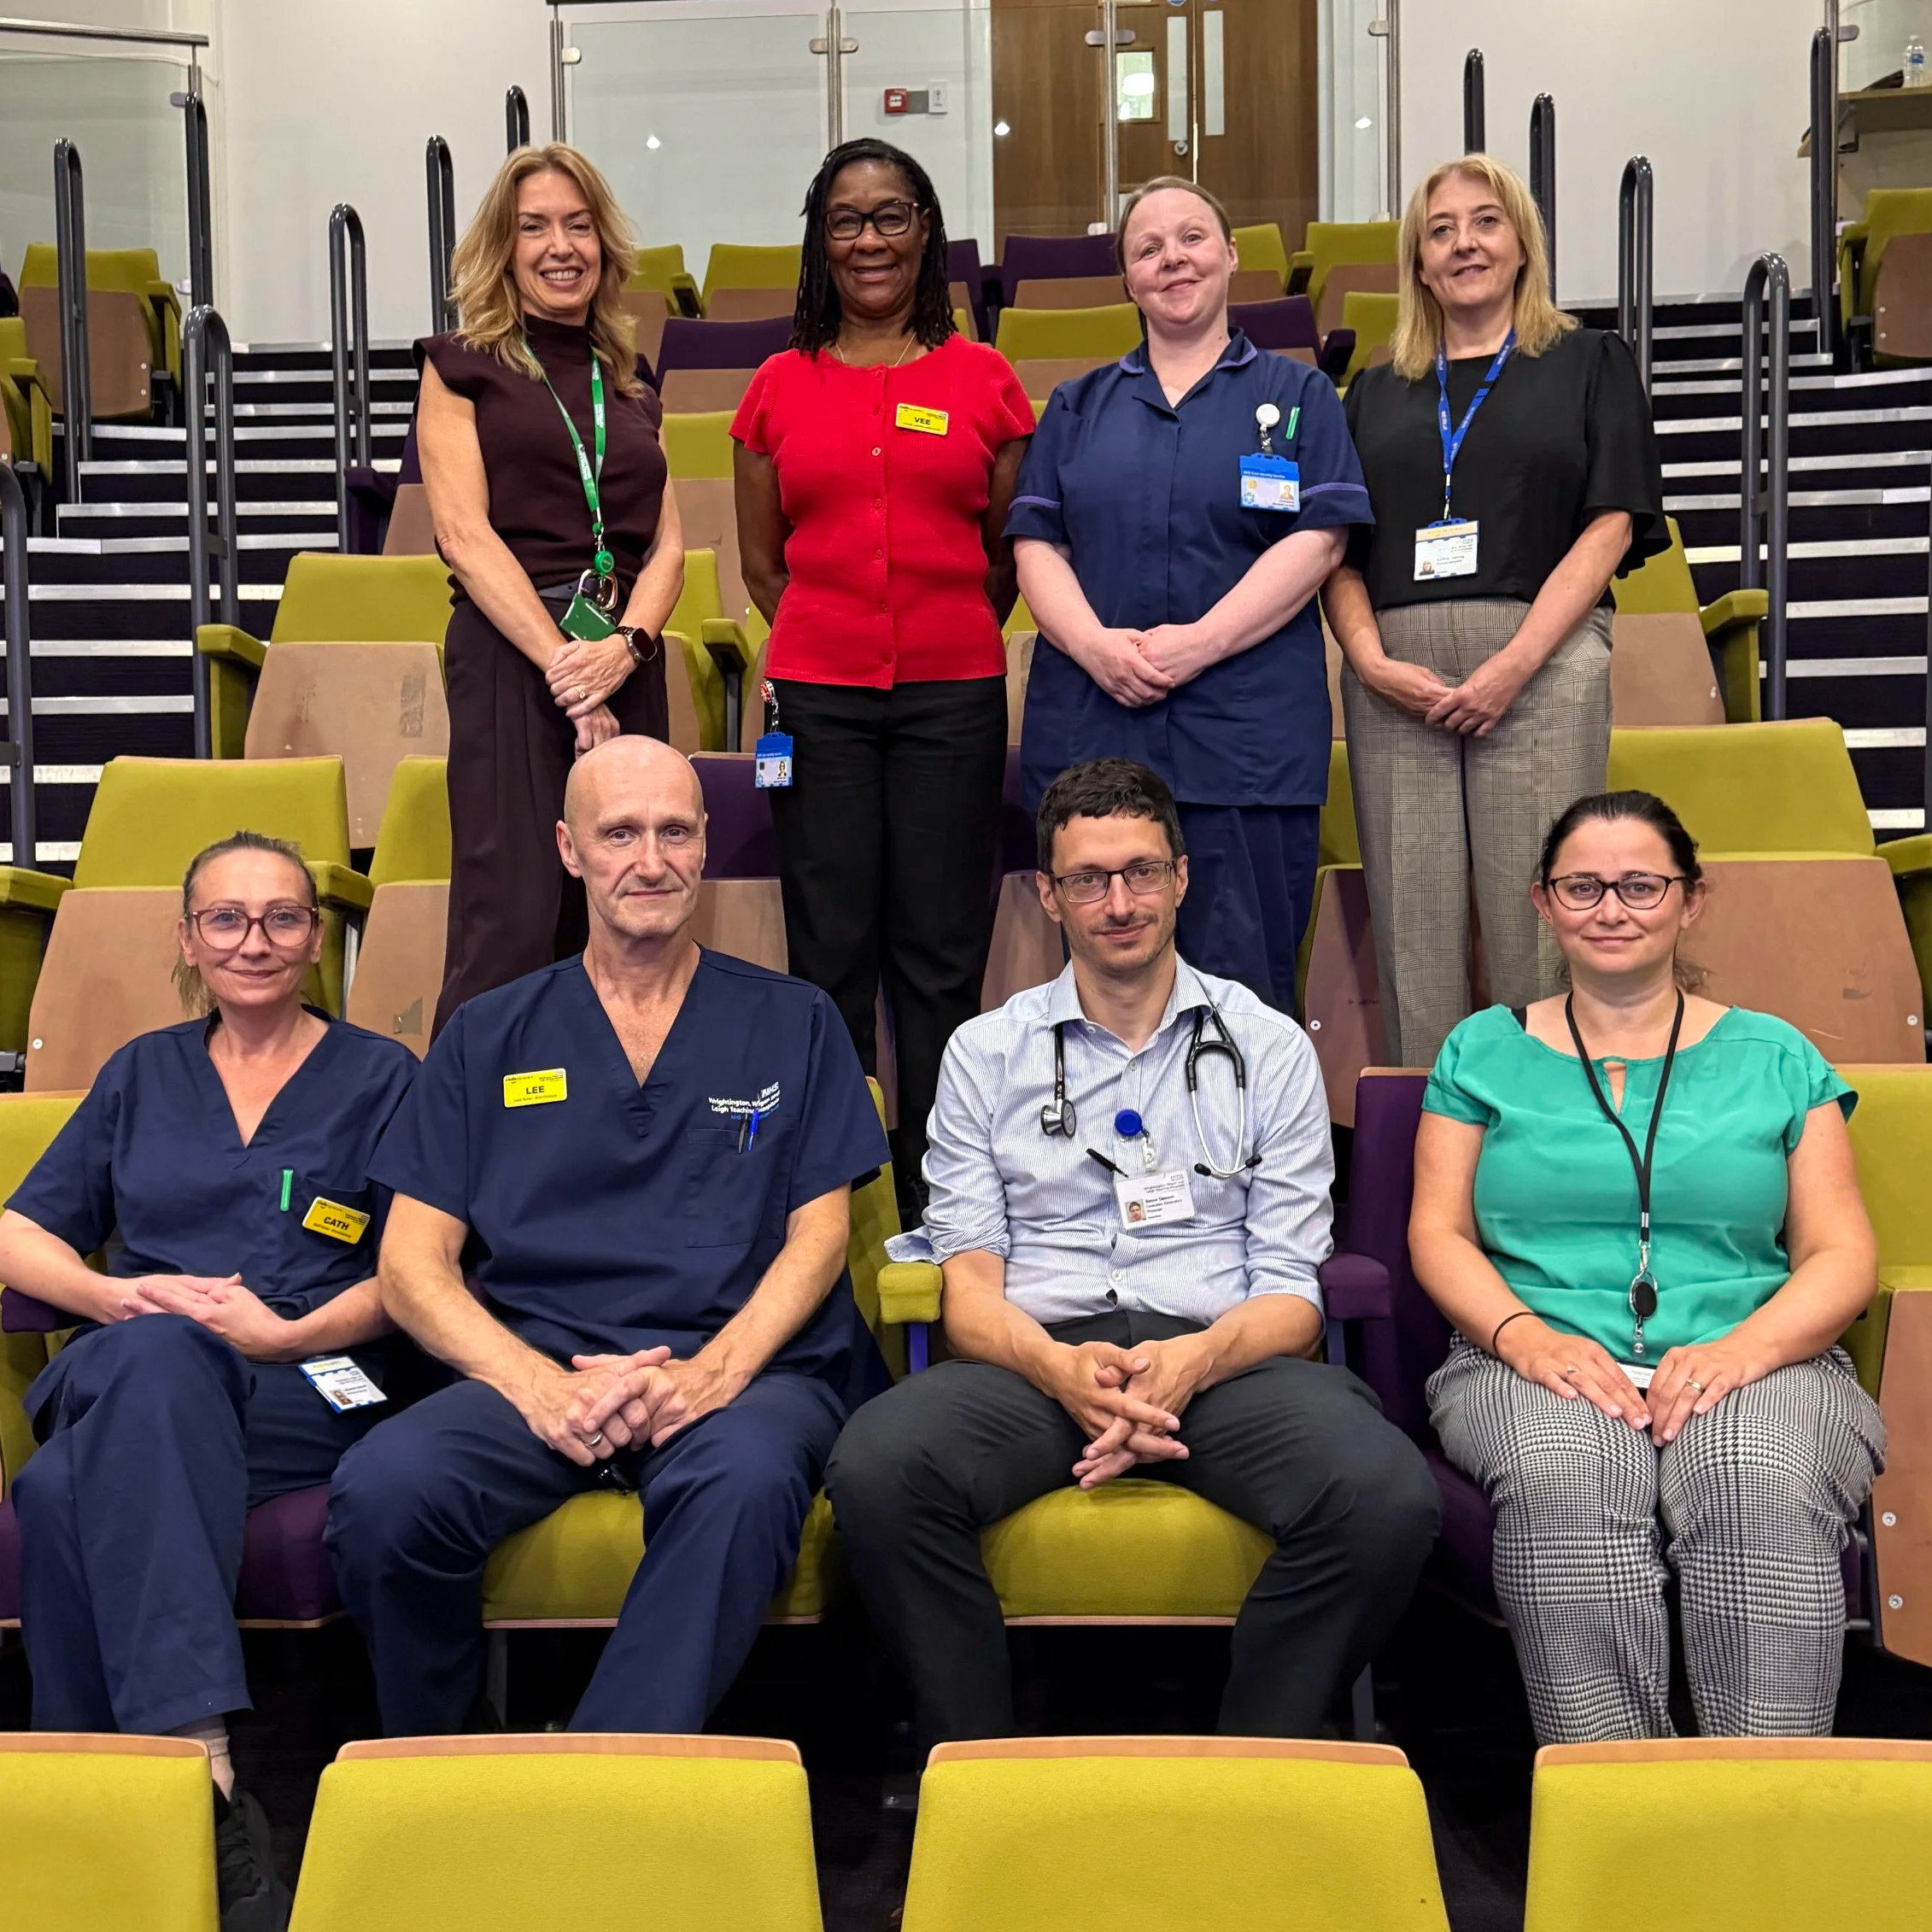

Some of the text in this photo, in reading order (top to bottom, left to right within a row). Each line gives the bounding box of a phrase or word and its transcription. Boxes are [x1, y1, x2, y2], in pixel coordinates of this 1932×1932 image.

[914, 416, 931, 425] VEE
[526, 1085, 545, 1095] LEE
[761, 1081, 779, 1099] NHS
[711, 1105, 729, 1115] Leigh
[324, 1215, 349, 1231] CATH
